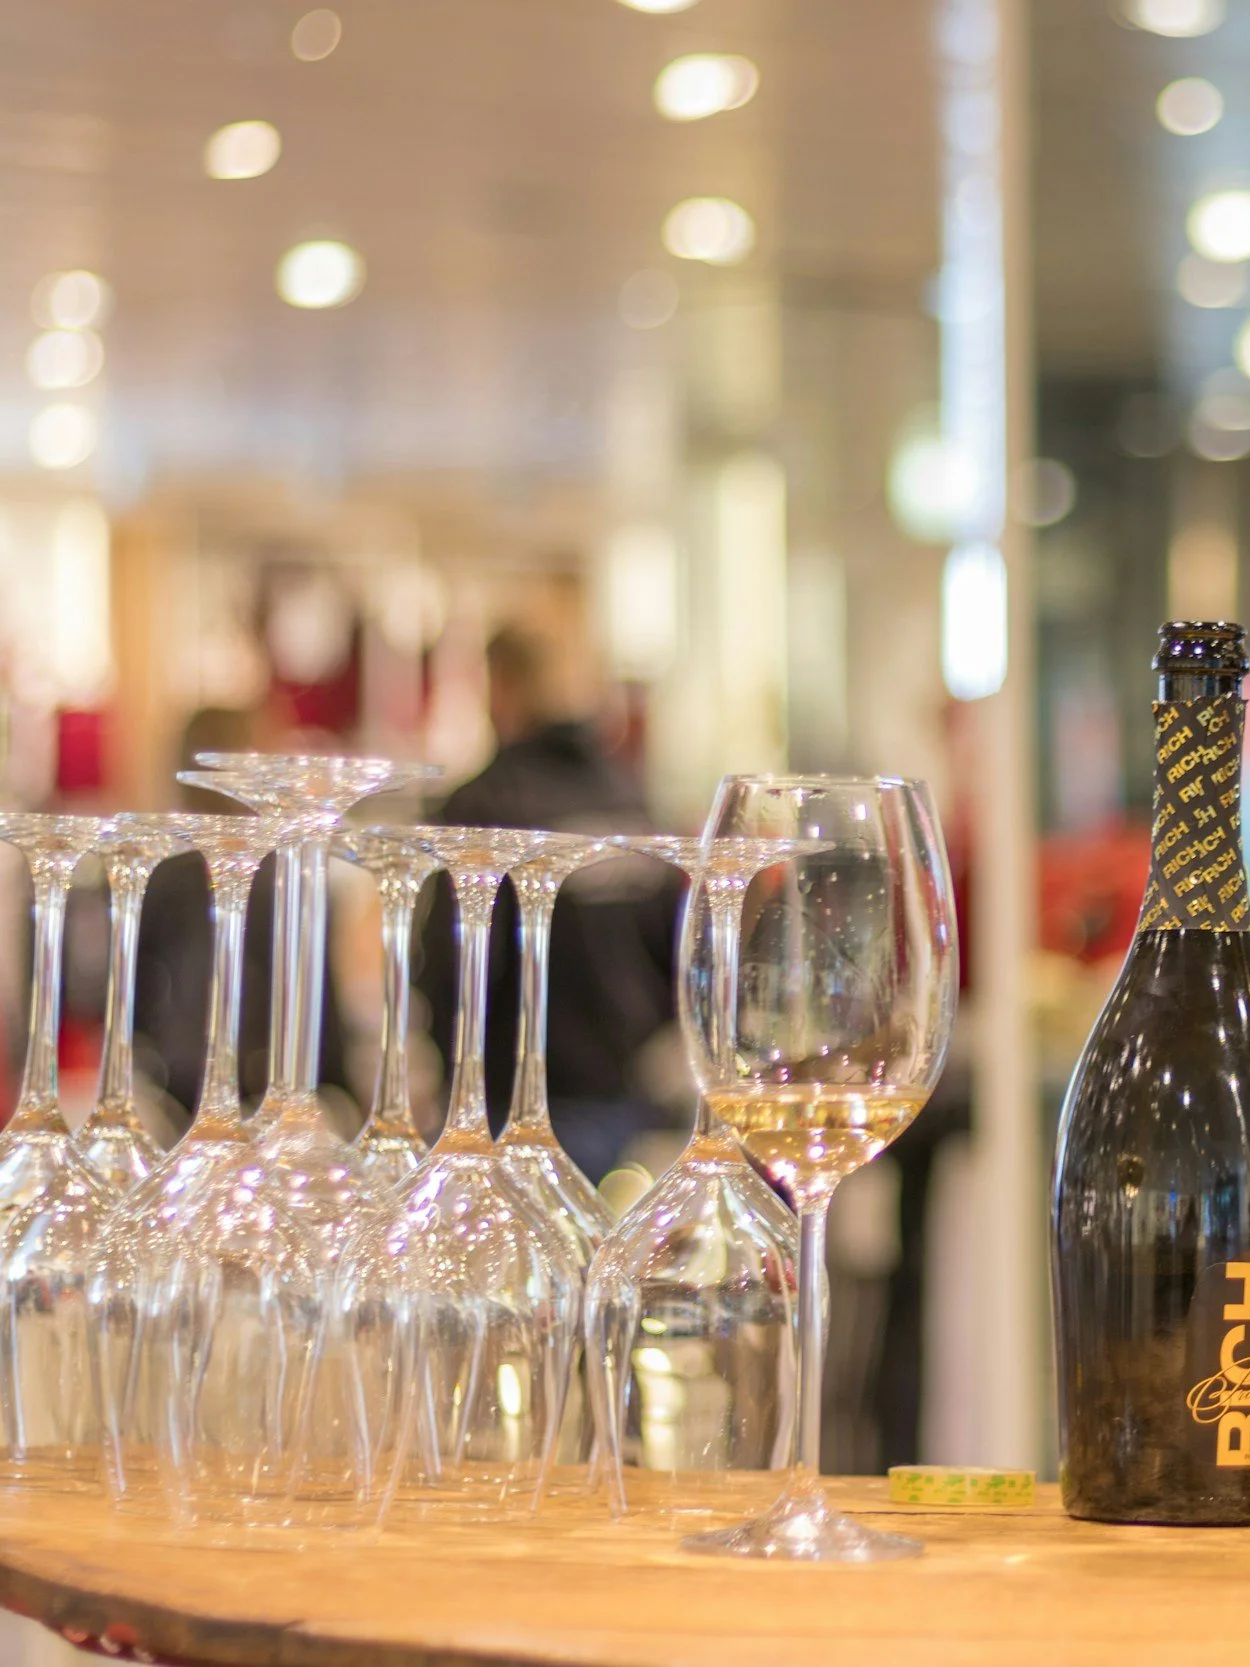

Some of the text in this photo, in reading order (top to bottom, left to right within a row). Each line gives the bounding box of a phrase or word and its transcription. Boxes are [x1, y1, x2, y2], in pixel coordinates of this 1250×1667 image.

[1157, 726, 1193, 764] RICH
[1167, 745, 1207, 784] RICH
[1154, 821, 1190, 861] RICH
[1163, 840, 1204, 878] RICH
[1173, 867, 1205, 898] RIC
[1203, 848, 1237, 884] RICH
